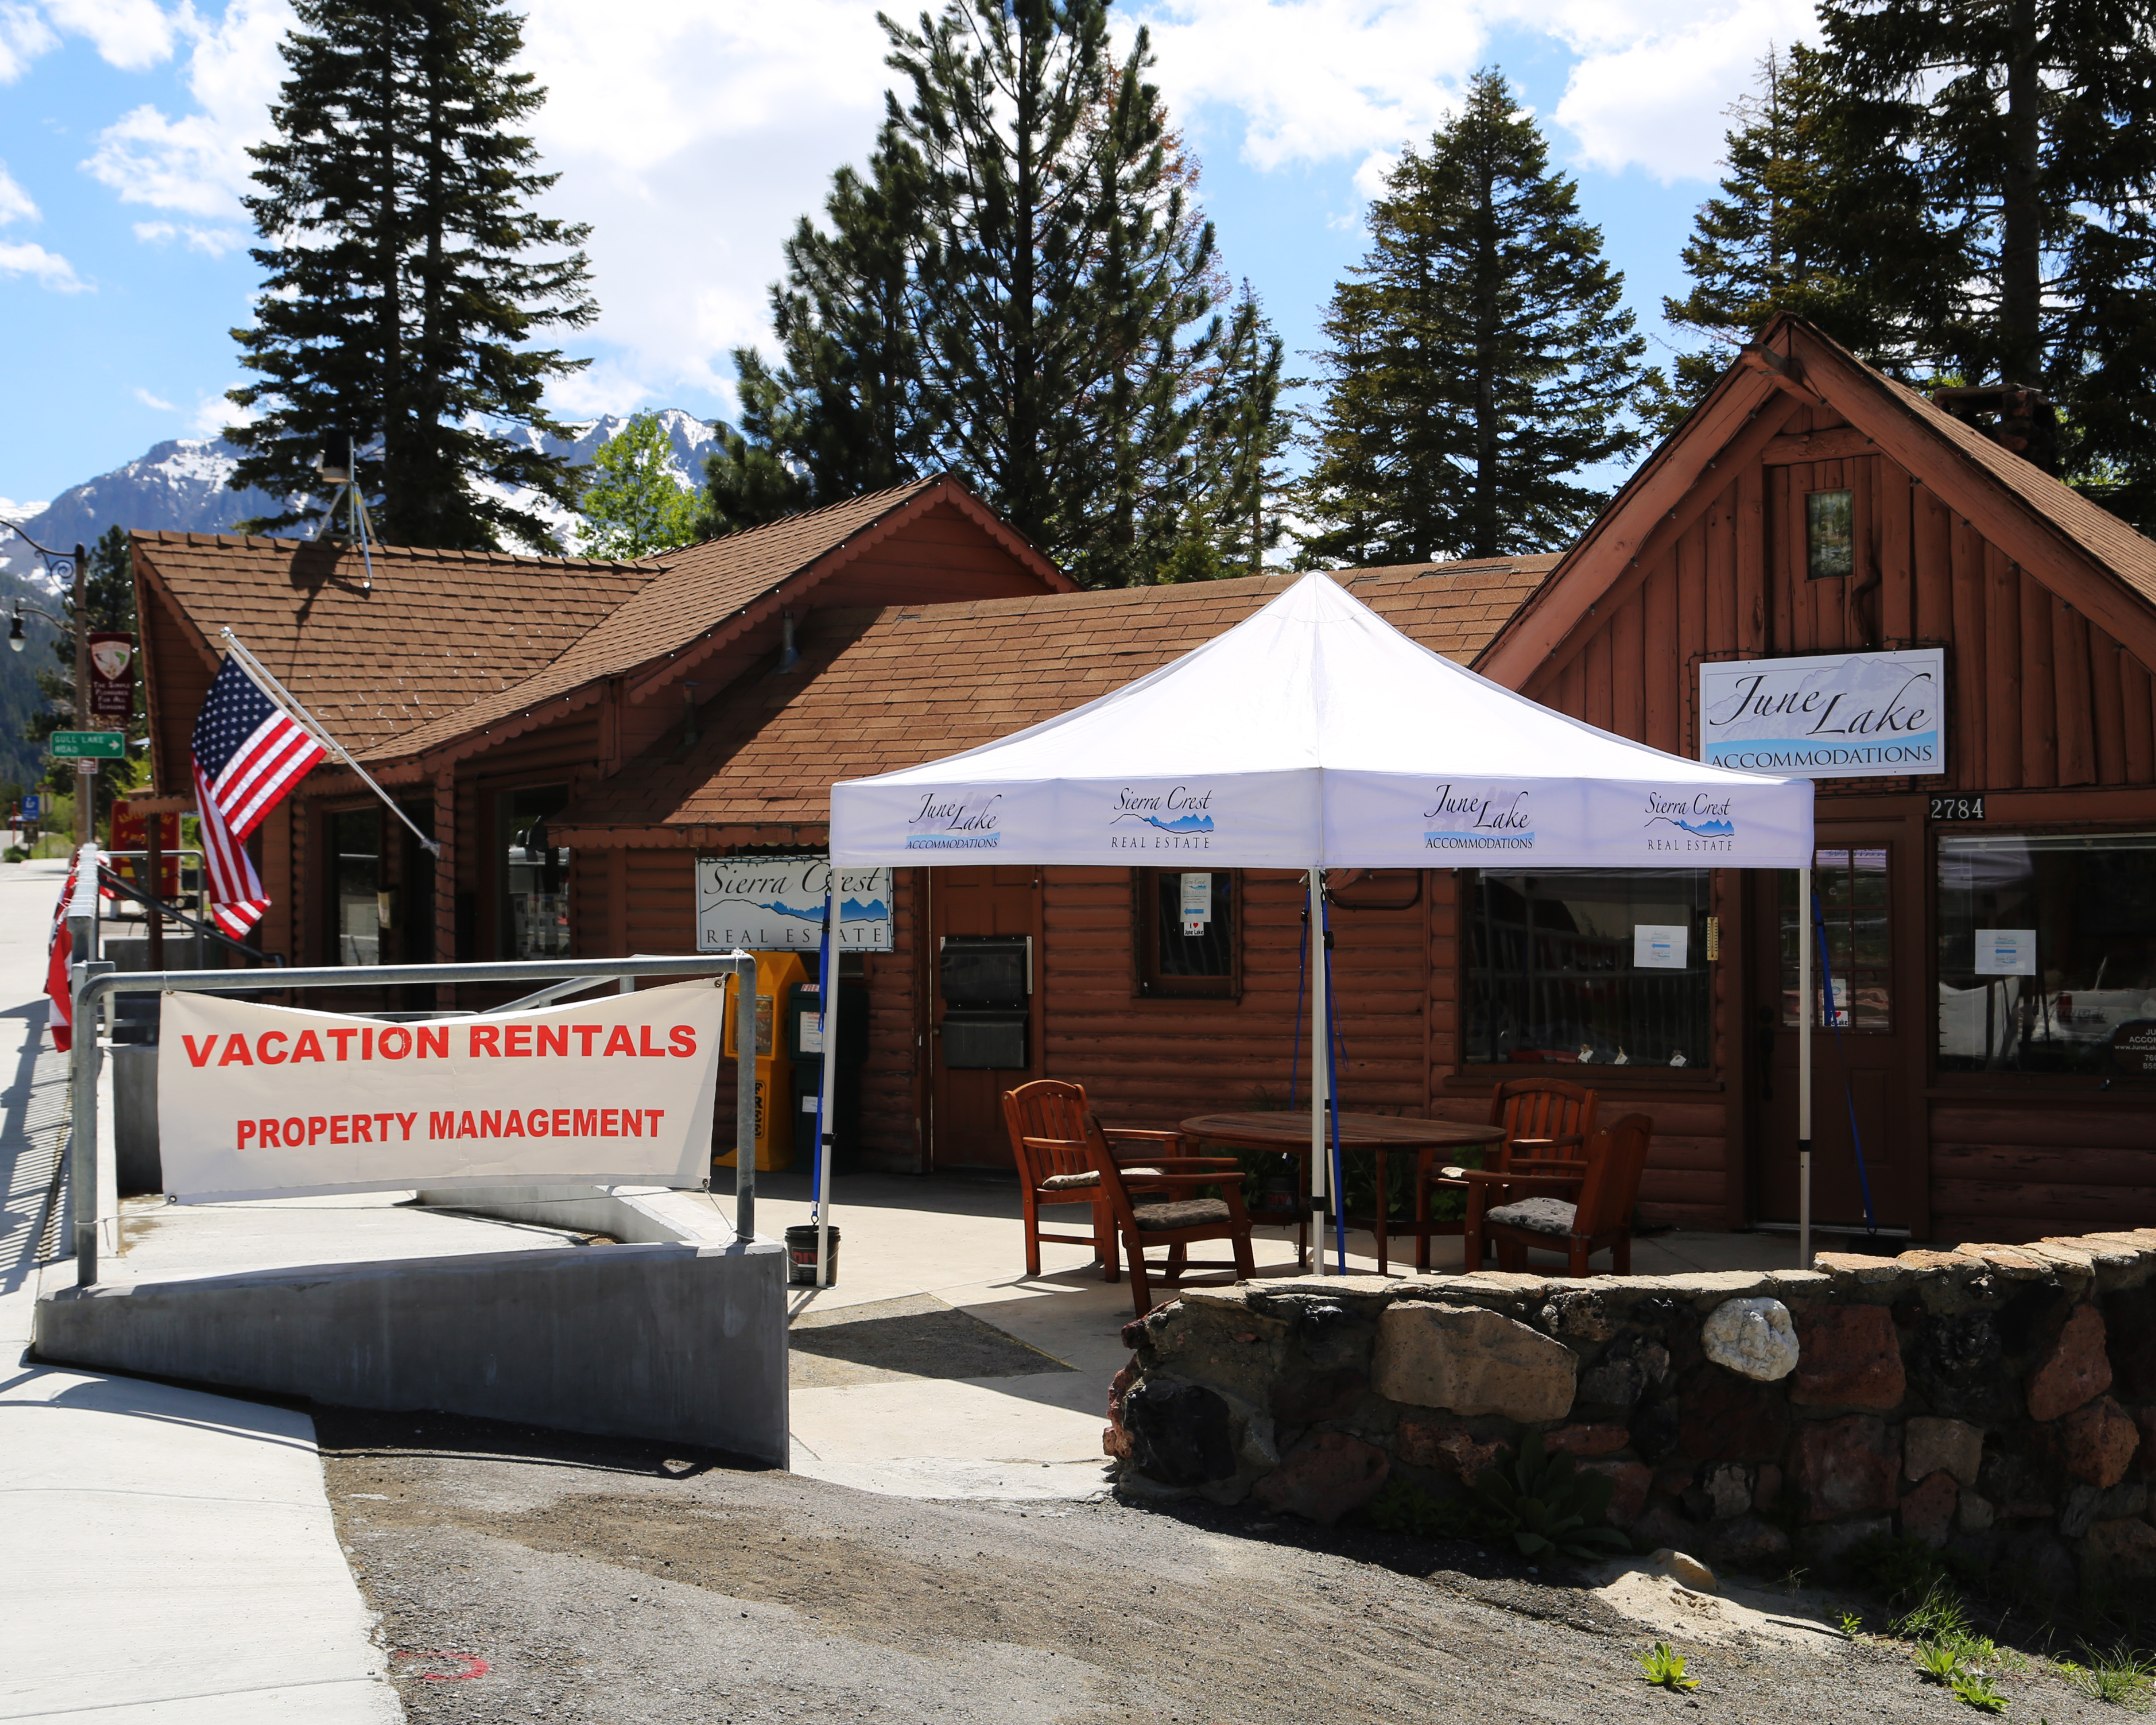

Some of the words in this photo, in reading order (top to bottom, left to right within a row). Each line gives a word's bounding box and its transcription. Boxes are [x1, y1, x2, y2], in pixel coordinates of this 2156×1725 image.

[1709, 675, 1826, 726] June
[1806, 672, 1932, 735] Lake
[55, 745, 79, 753] ROAD
[82, 736, 104, 744] LAKE
[1712, 745, 1932, 770] ACCOMMODATIONS
[1114, 788, 1163, 810] Sierra
[1167, 786, 1213, 810] Crest
[1424, 784, 1482, 817] June
[1473, 791, 1531, 829] Lake
[1645, 792, 1689, 813] Sierra
[1693, 793, 1732, 815] Crest
[1931, 798, 1983, 819] 2784
[909, 793, 955, 823] June
[946, 794, 1002, 830] Lake
[905, 838, 998, 849] ACCOMMODATIONS
[1111, 837, 1146, 848] REAL
[1155, 838, 1209, 848] ESTATE
[1425, 838, 1533, 849] ACCOMMODATIONS
[1647, 840, 1680, 850] REAL
[1687, 840, 1732, 851] ESTATE
[704, 865, 794, 894] Sierra
[802, 862, 883, 893] Cest
[707, 929, 769, 943] REAL
[182, 1026, 449, 1067] VACATION
[470, 1025, 697, 1057] RENTALS
[237, 1112, 418, 1150] PROPERTY
[429, 1109, 664, 1139] MANAGEMENT
